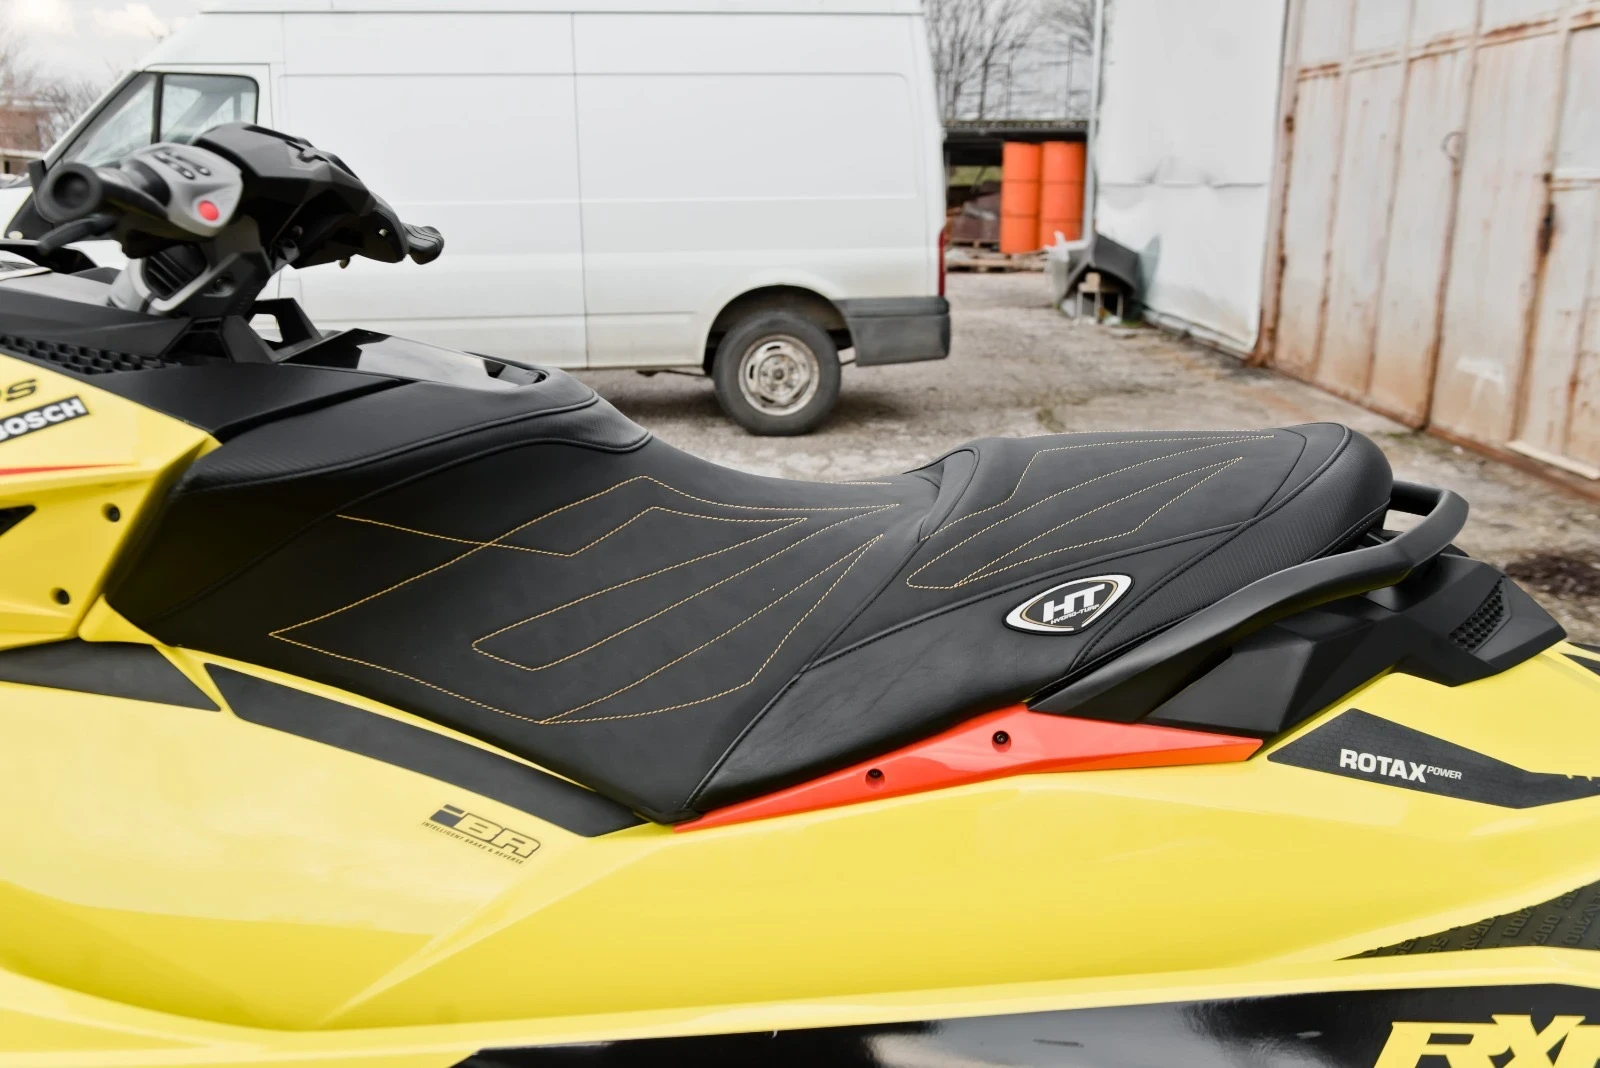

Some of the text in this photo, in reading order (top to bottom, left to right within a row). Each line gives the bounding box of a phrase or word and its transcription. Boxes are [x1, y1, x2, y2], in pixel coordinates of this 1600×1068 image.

[1042, 583, 1106, 622] HT
[1050, 603, 1100, 625] HYDRO-TURF
[1339, 748, 1463, 783] ROTAX POWER
[421, 821, 464, 840] INTELLIGENT
[464, 838, 486, 850] BRAKE
[494, 850, 524, 865] REVERSE
[1373, 1014, 1600, 1068] RX
